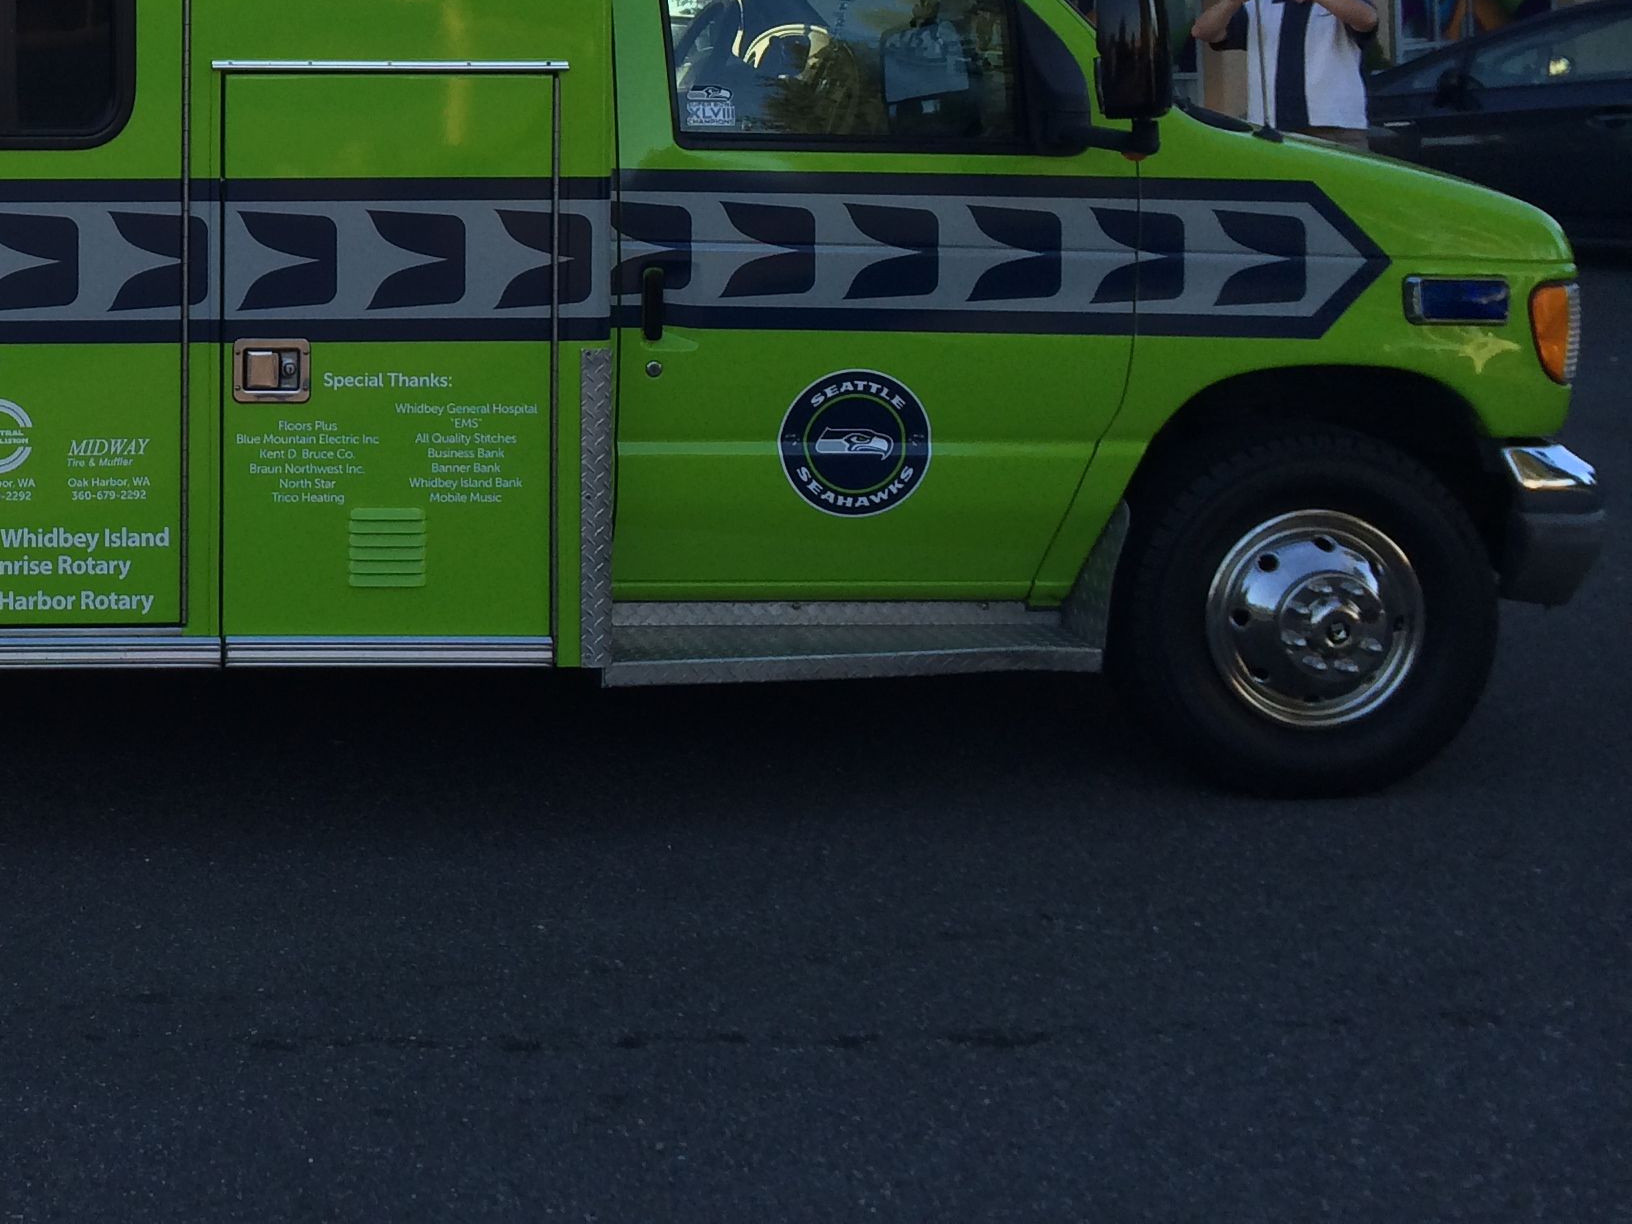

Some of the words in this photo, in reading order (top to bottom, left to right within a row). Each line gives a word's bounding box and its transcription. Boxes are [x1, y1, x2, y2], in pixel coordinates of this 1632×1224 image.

[323, 373, 383, 390] Special
[387, 373, 452, 388] Thanks:
[810, 380, 906, 410] SEATTLE
[395, 403, 444, 416] Whidbey
[447, 403, 489, 414] General
[493, 403, 538, 416] Hospital
[315, 420, 338, 431] Plus
[236, 434, 261, 444] Blue
[263, 434, 316, 444] Mountain
[319, 434, 359, 444] Electric
[415, 433, 429, 444] All
[431, 433, 471, 446] Quality
[474, 433, 517, 444] Stitches
[68, 438, 150, 456] MIDWAY
[427, 448, 474, 458] Business
[477, 448, 505, 458] Bank
[259, 449, 284, 459] Kent
[302, 449, 334, 459] Bruce
[249, 463, 282, 474] Braun
[285, 463, 343, 474] Northwest
[431, 463, 471, 473] Banner
[473, 463, 501, 473] Bank
[17, 478, 36, 488] WA
[67, 478, 88, 488] Oak
[132, 476, 151, 486] WA
[279, 478, 311, 488] North
[315, 478, 336, 488] Star
[409, 477, 458, 490] Whidbey
[460, 477, 492, 488] Island
[495, 477, 523, 488] Bank
[796, 466, 914, 508] SEAHAWKS
[302, 492, 345, 505] Heating
[429, 492, 468, 503] Mobile
[470, 492, 502, 503] Music
[0, 527, 100, 552] Whidbey
[104, 526, 170, 547] Island
[58, 555, 131, 580] Rotary
[80, 590, 154, 615] Rotary
